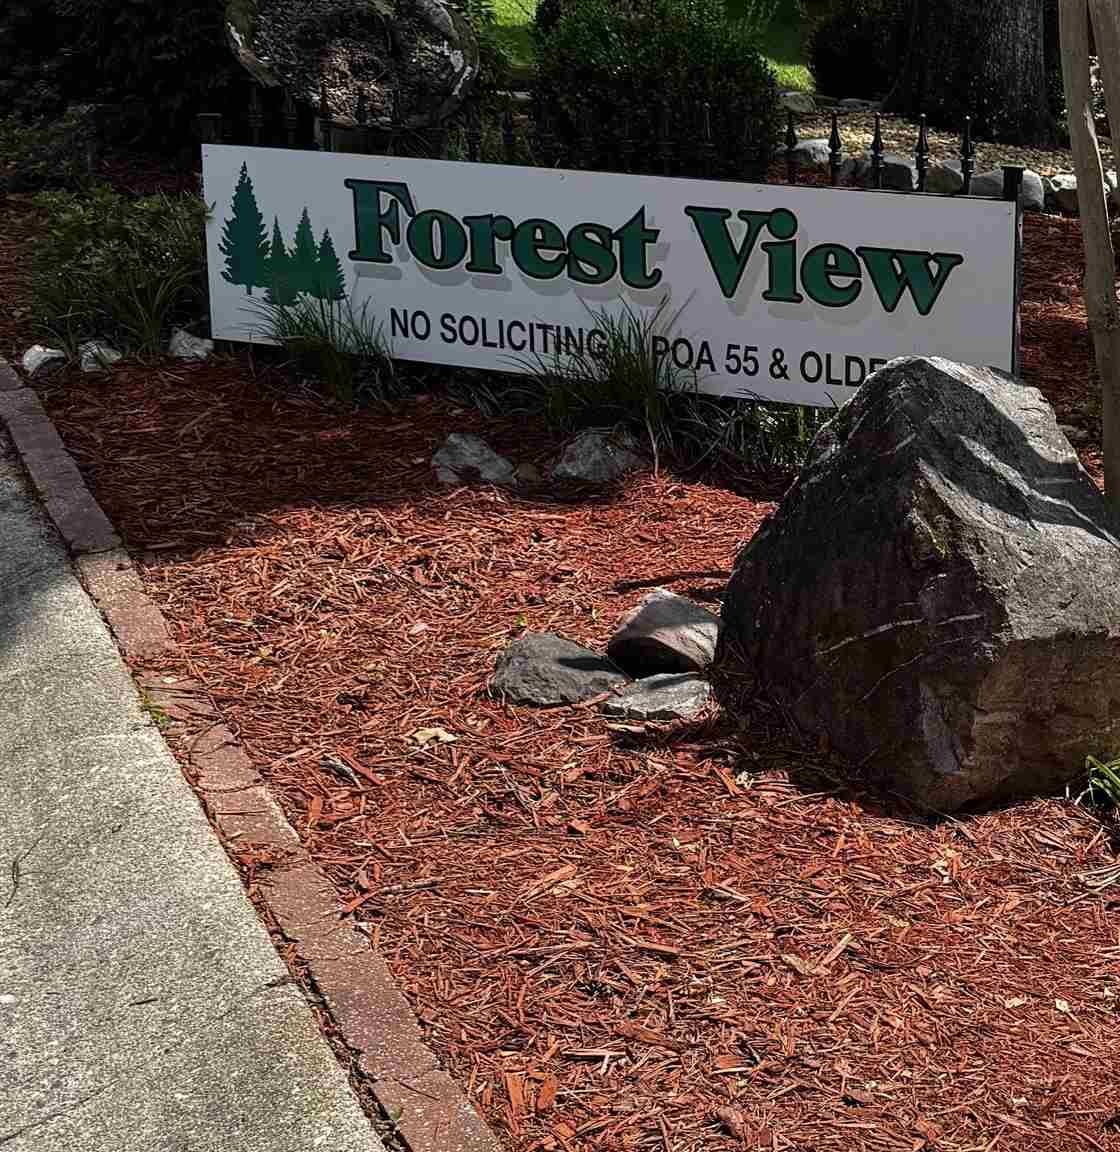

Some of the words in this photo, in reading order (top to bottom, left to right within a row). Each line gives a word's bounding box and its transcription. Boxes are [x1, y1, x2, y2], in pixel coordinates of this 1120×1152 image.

[344, 178, 661, 289] Forest
[684, 206, 964, 316] View
[390, 307, 431, 340] NO
[440, 313, 608, 359] SOLICITING
[725, 343, 760, 376] 55
[769, 348, 790, 380] &
